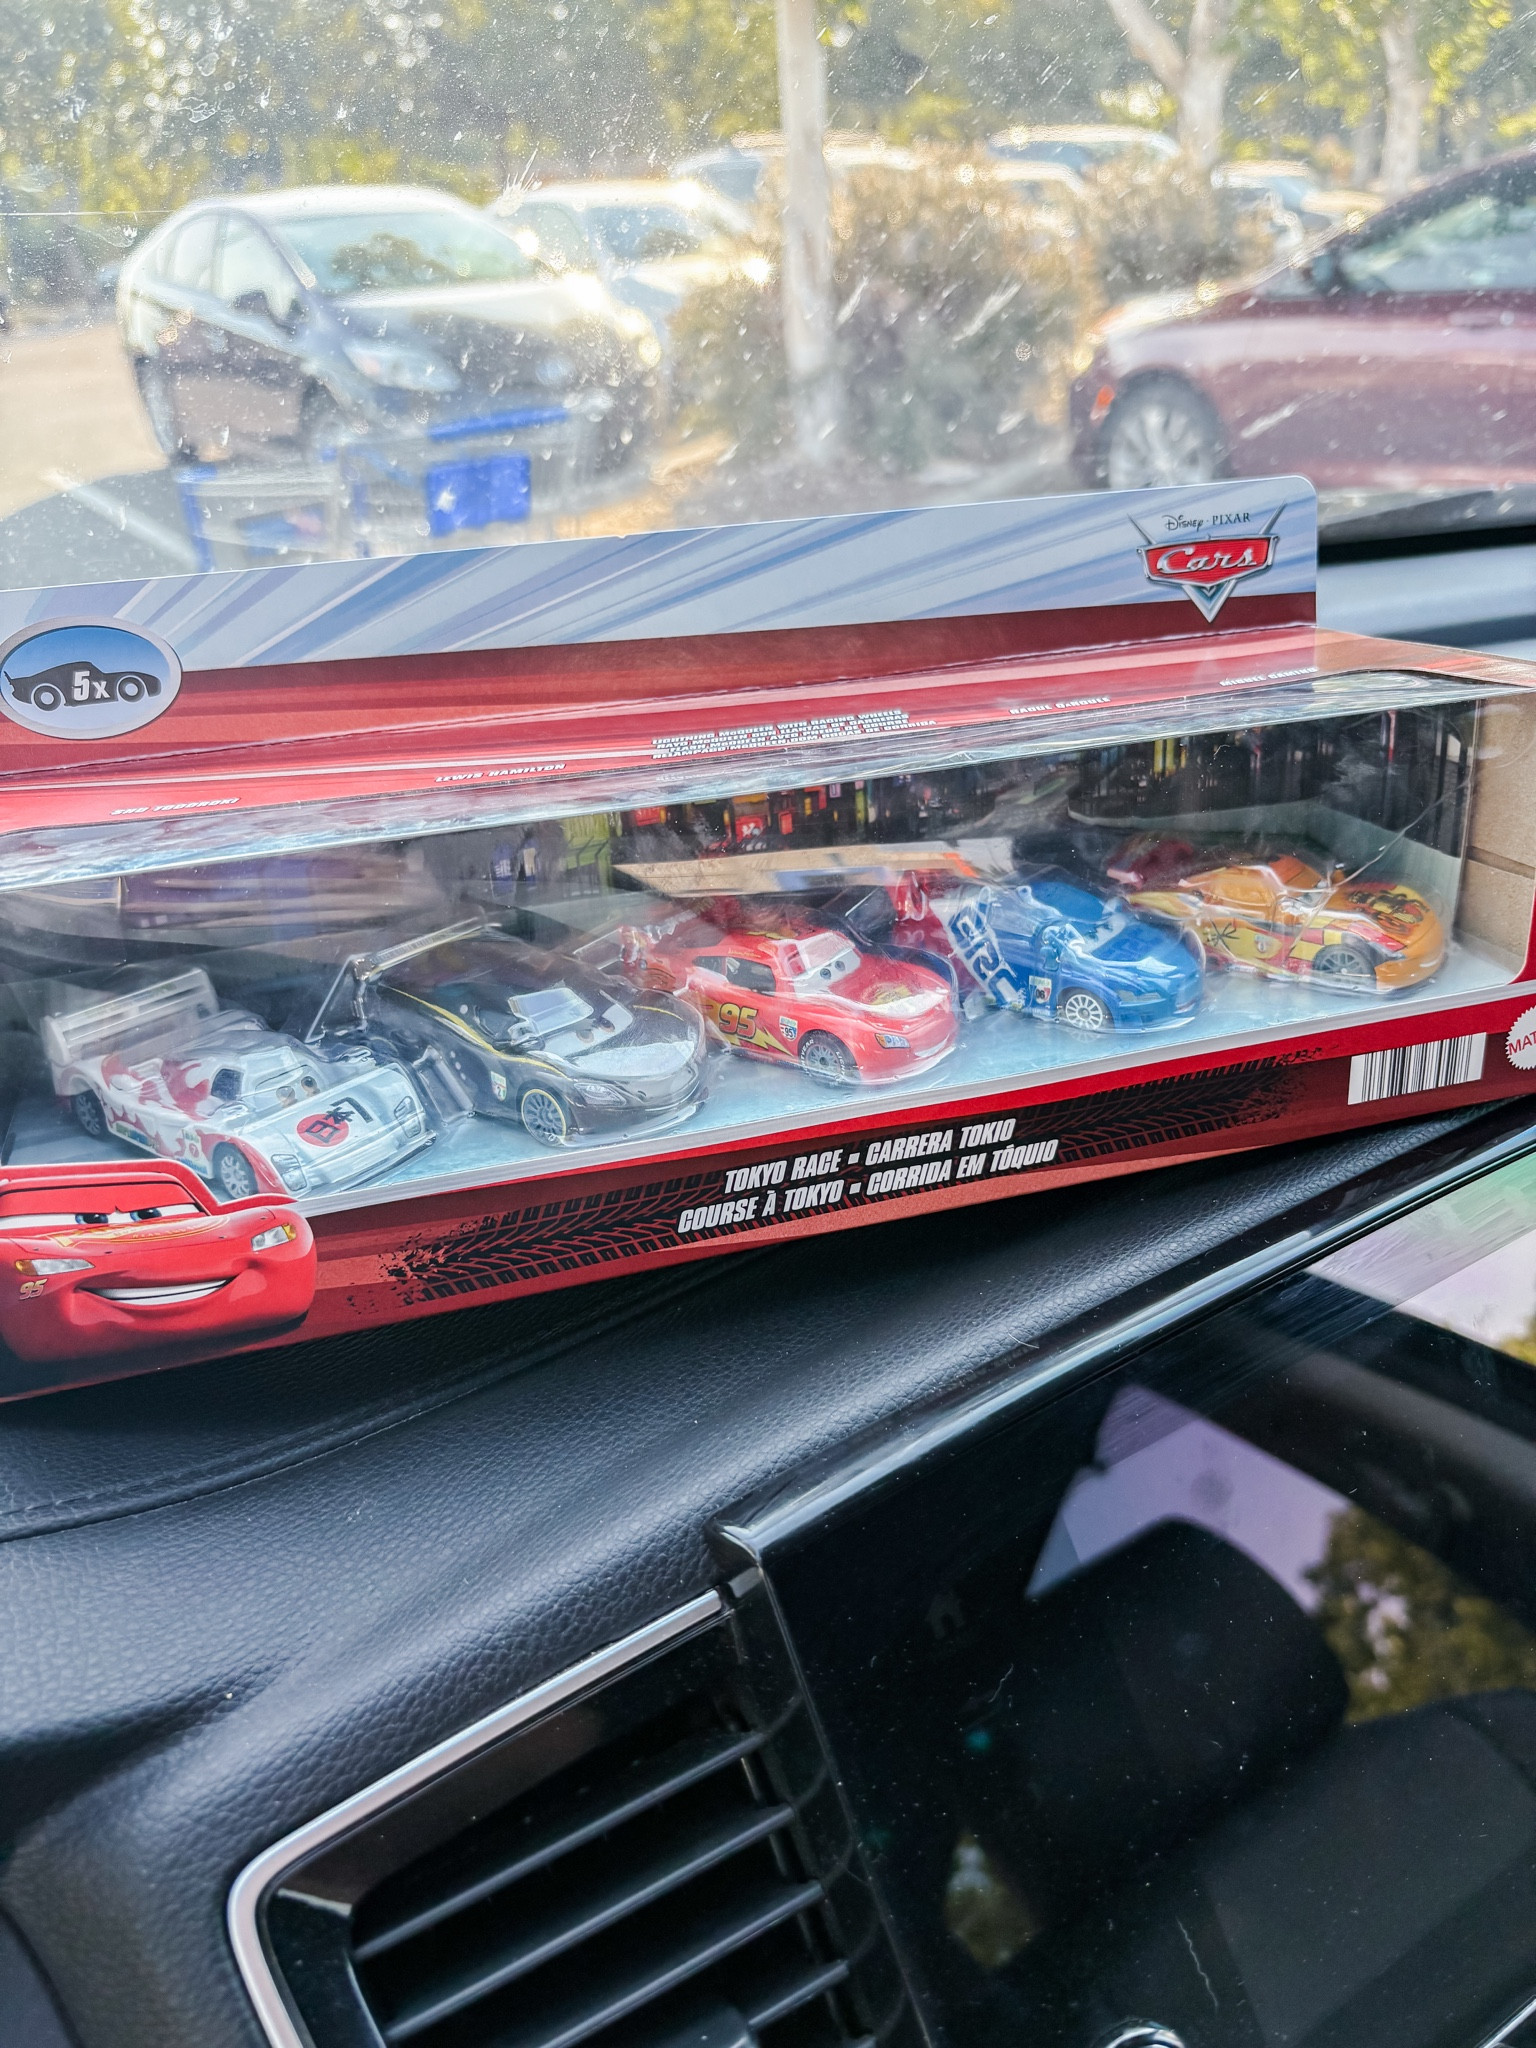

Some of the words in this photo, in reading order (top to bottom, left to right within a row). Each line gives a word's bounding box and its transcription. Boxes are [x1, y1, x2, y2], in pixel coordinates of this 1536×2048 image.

[1161, 514, 1204, 532] Disney
[1212, 512, 1251, 526] PIXAR
[1156, 546, 1257, 574] Cars
[73, 670, 111, 701] 5x
[1009, 704, 1052, 715] RAOUL
[652, 731, 715, 745] LIGHTNING
[776, 721, 807, 730] WITH
[810, 716, 855, 726] RACING
[857, 710, 902, 720] WHEELS
[435, 772, 484, 782] LEWIS
[488, 763, 566, 777] HAMILTON
[152, 797, 241, 812] TODOROKI
[718, 1001, 758, 1040] 95
[784, 1027, 794, 1038] 95
[724, 1159, 788, 1194] TOKYO
[790, 1152, 844, 1181] RACE
[864, 1129, 953, 1167] CARRERA
[959, 1118, 1017, 1147] TOKIO
[676, 1199, 759, 1234] COURSE
[761, 1189, 776, 1218] À
[783, 1180, 842, 1212] TOKYO
[866, 1161, 951, 1197] CORRIDA
[954, 1153, 985, 1179] EM
[988, 1139, 1060, 1173] TÓQUIO
[19, 1278, 48, 1301] 95
